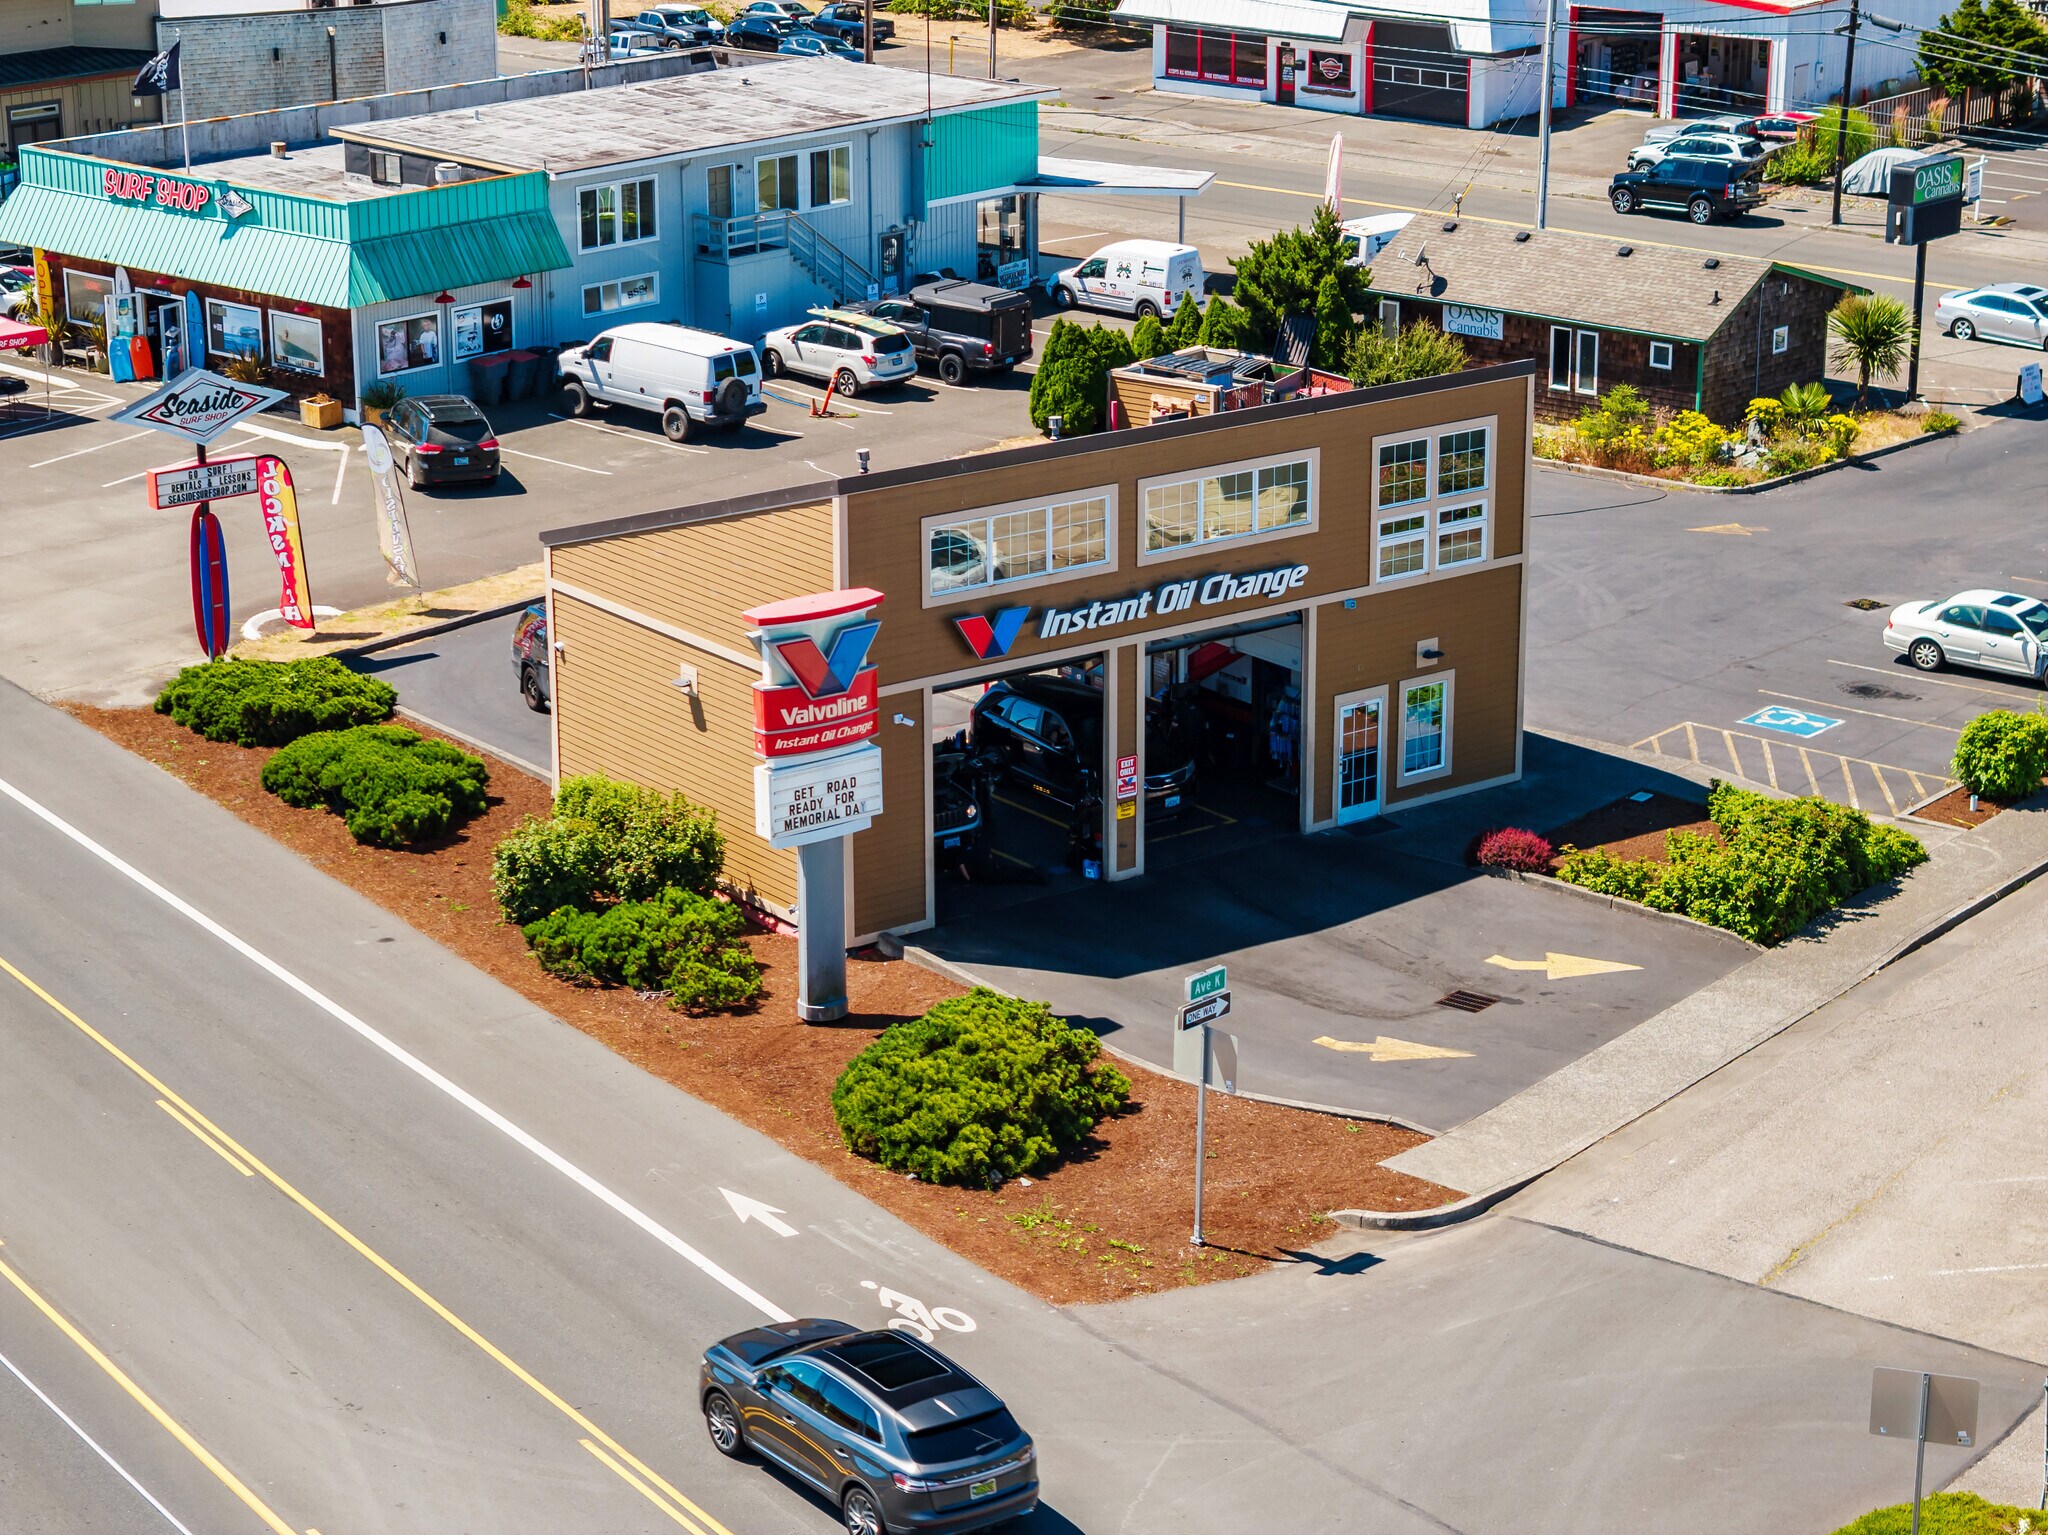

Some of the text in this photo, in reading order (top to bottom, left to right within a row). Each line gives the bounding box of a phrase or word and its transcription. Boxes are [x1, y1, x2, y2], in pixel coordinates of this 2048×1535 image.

[1916, 164, 1952, 190] OASIS
[104, 168, 209, 212] SURF SHOP
[1924, 180, 1960, 199] Cannabis
[1448, 304, 1498, 325] OASIS
[1448, 320, 1498, 338] Cannabis
[9, 337, 28, 346] SHOP
[160, 387, 244, 418] Seaside
[180, 412, 228, 426] SURF SHOP
[171, 472, 251, 494] RENTALS & LESSONS
[188, 470, 198, 480] GO
[168, 482, 248, 504] SEASIDESURFSHOP.COM
[1039, 591, 1152, 639] Instant
[1155, 580, 1198, 615] Oil
[1200, 564, 1308, 606] Change
[780, 695, 868, 726] Valvoline
[774, 721, 874, 750] Instant Oil Change
[1120, 767, 1134, 776] ONLY
[794, 776, 857, 802] GET ROAD
[789, 790, 854, 816] READY FOR
[784, 801, 866, 831] MEMORIAL DAY
[1194, 974, 1220, 996] Ave K
[1188, 1004, 1216, 1022] ONE WAY
